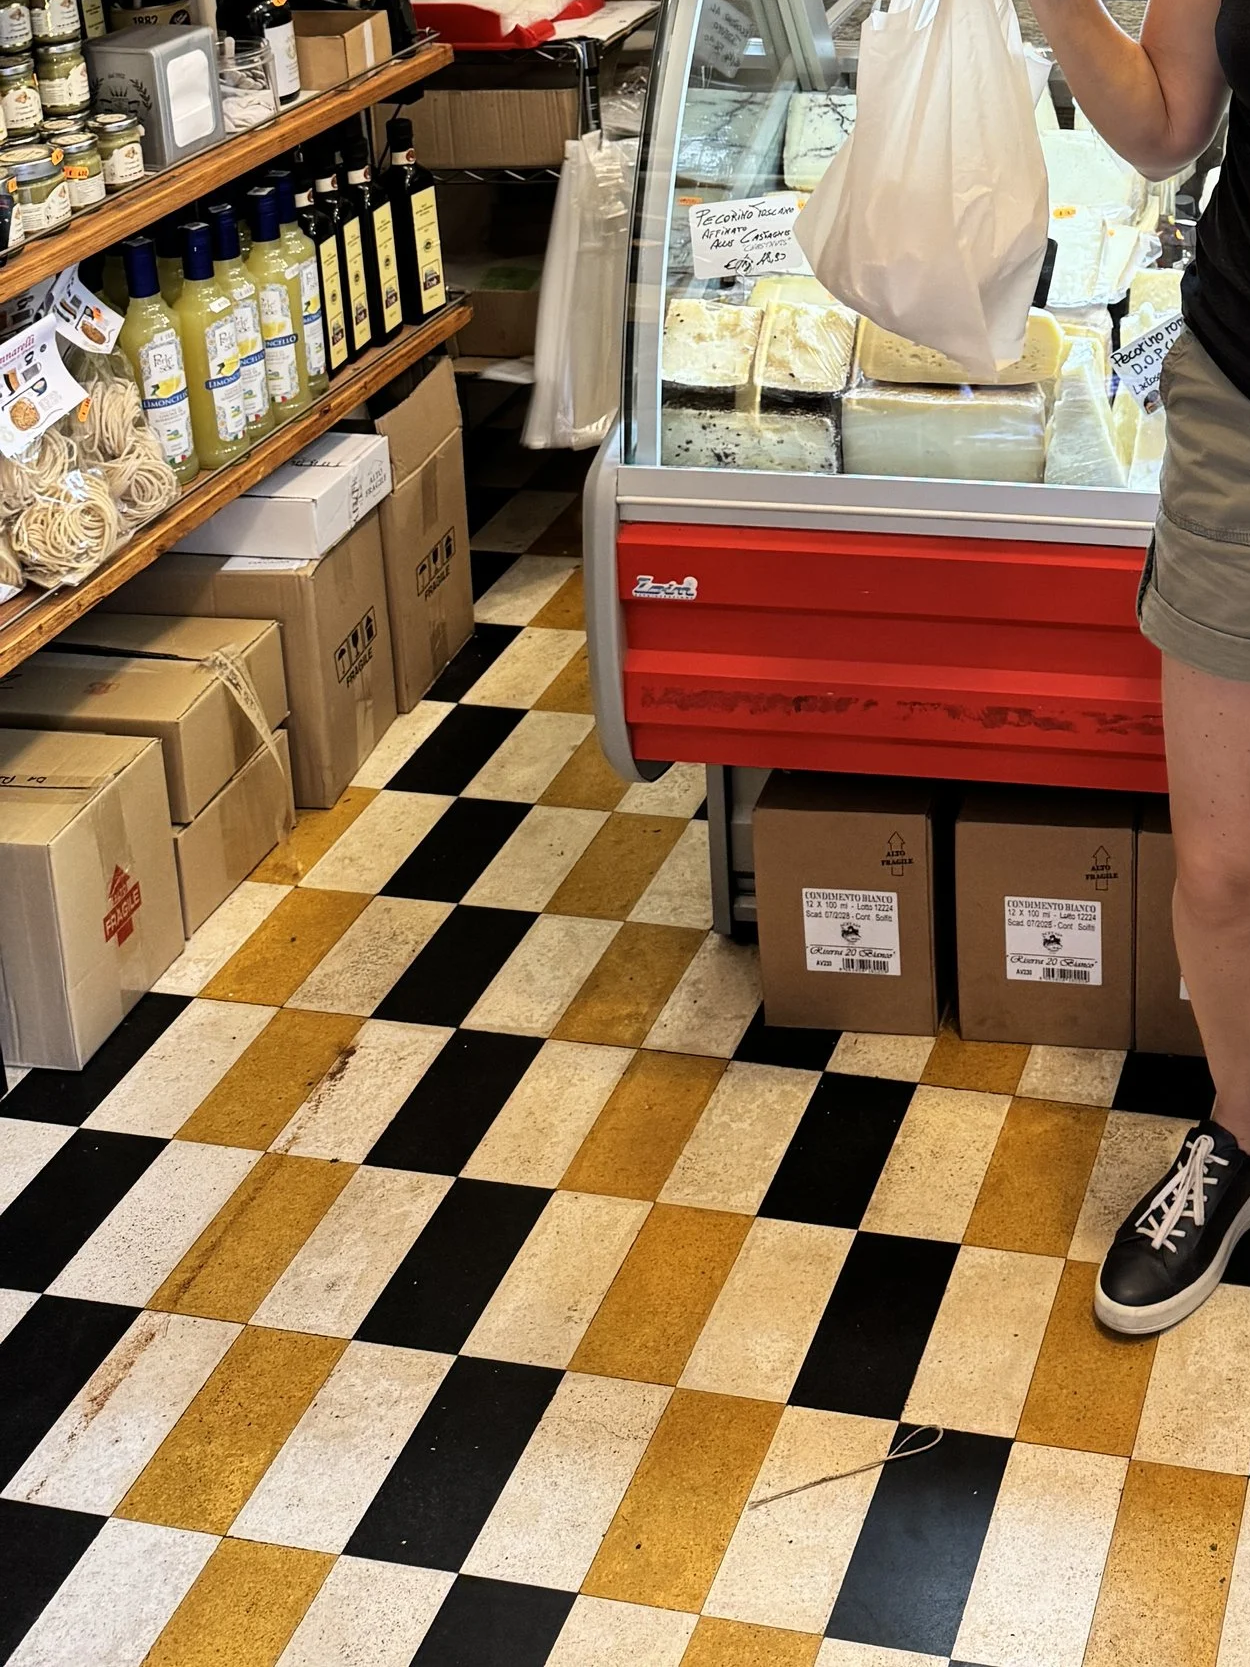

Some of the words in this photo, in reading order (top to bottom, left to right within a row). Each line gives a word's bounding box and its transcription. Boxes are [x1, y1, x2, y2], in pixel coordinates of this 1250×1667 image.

[1110, 332, 1164, 368] Pecorino
[424, 564, 452, 602] FRAGILE
[346, 646, 374, 689] FRAGILE
[886, 850, 906, 858] ALTO
[881, 858, 914, 866] FRAGILE
[1090, 864, 1111, 872] ALTO
[1085, 872, 1119, 880] FRAGILE
[804, 891, 862, 902] CONDIMENTO
[862, 894, 893, 904] BIANCO
[806, 900, 814, 908] 12
[825, 901, 837, 909] 100
[874, 904, 893, 912] 12224
[1007, 900, 1064, 911] CONDIMENTO
[1064, 902, 1096, 913] BIANCO
[105, 889, 141, 936] FRAGILE
[1027, 910, 1039, 918] 100
[1077, 913, 1096, 921] 12224
